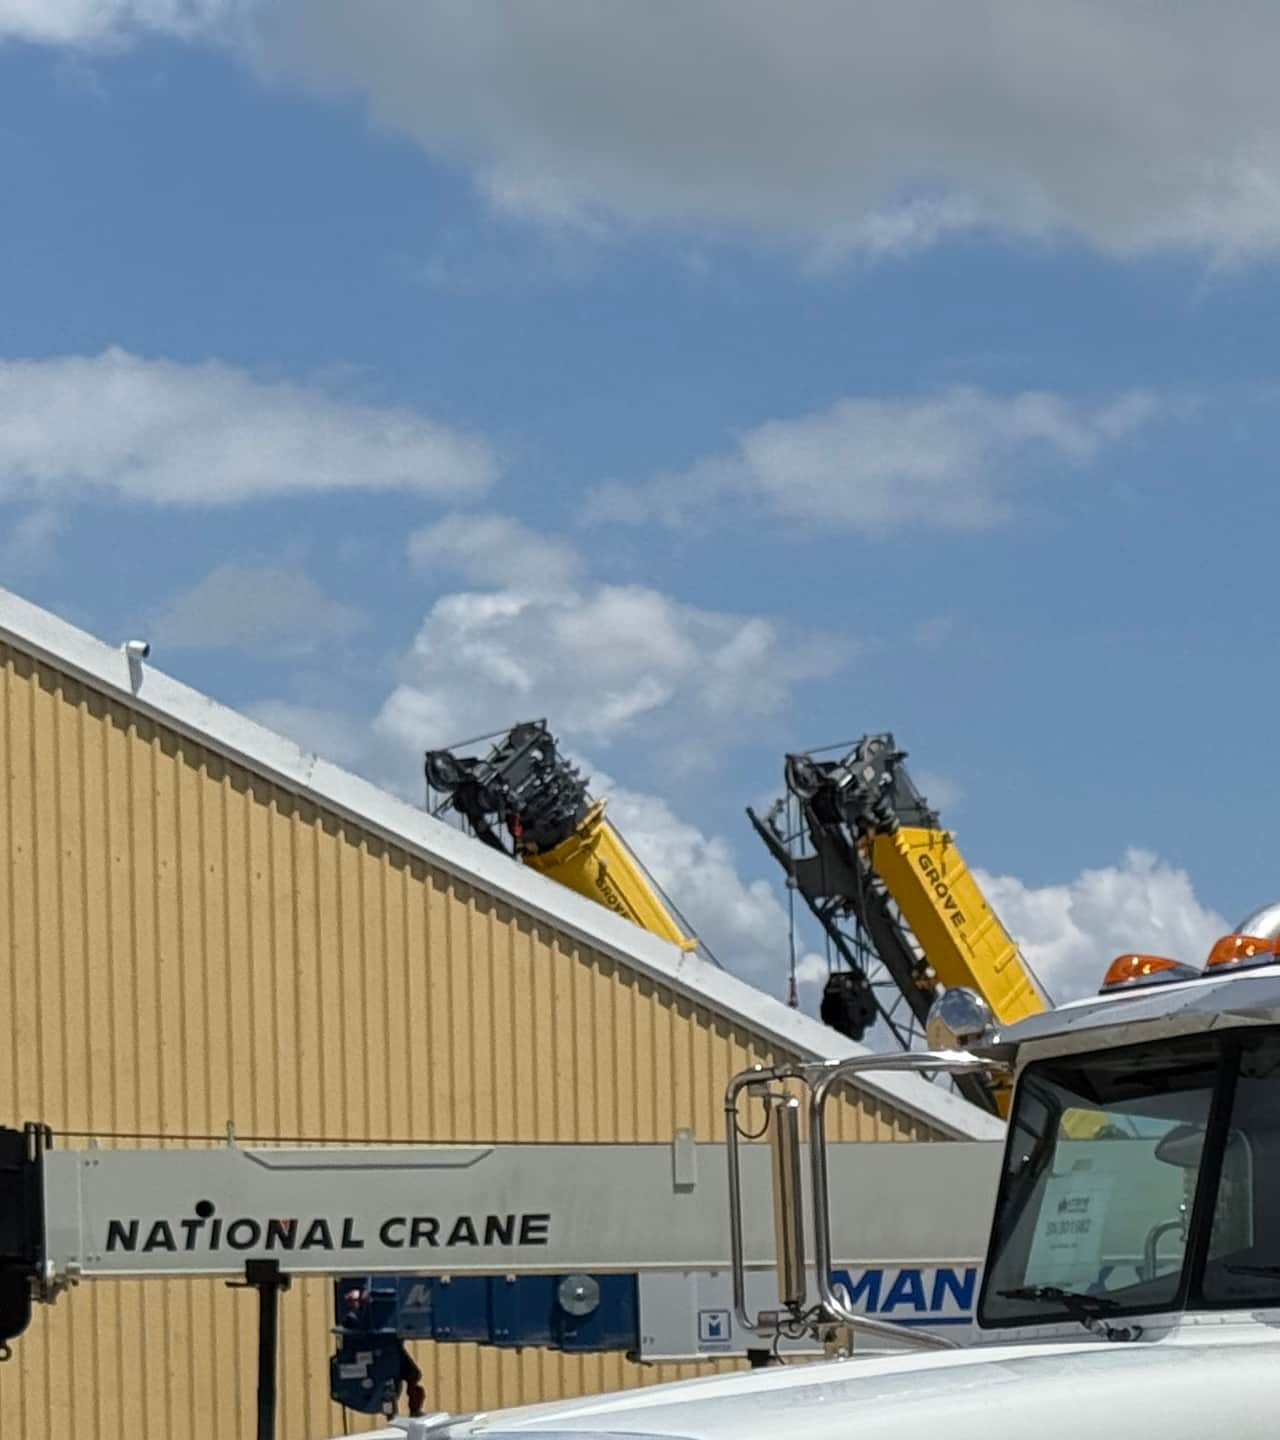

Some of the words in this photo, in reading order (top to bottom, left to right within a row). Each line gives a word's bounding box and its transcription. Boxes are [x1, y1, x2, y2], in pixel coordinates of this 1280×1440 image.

[918, 853, 967, 928] GROVE
[105, 1217, 366, 1252] NATIONAL
[379, 1213, 552, 1248] CRANE
